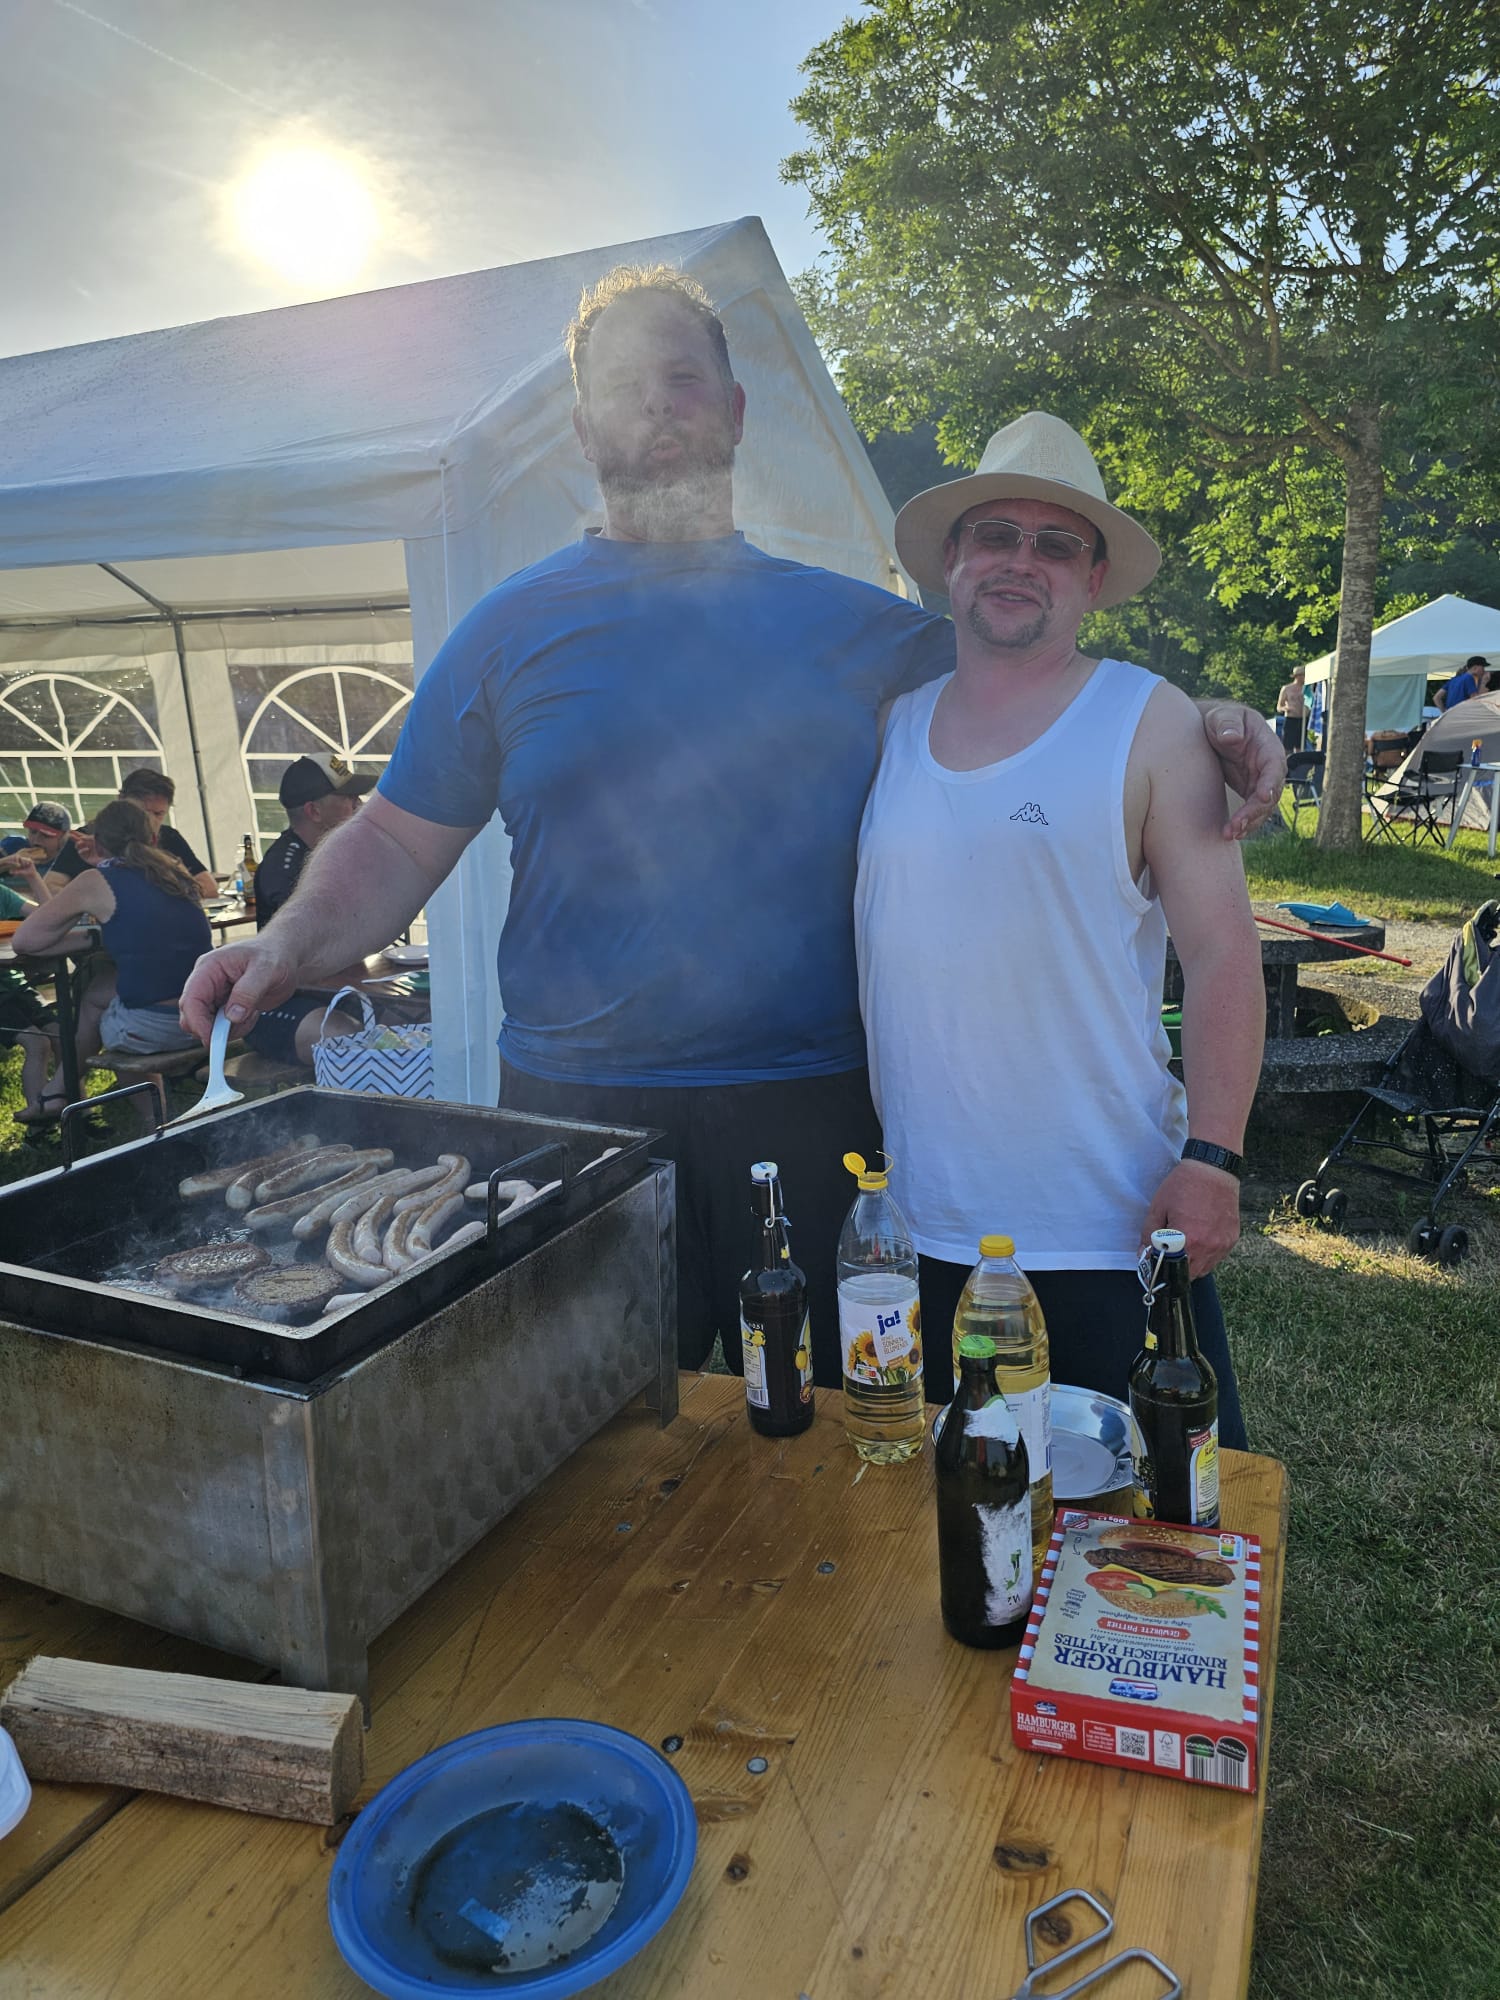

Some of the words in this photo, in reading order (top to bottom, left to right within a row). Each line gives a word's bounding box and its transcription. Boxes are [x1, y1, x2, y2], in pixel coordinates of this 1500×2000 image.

[876, 1310, 901, 1336] ja!
[1054, 1633, 1121, 1655] PATTIES
[1054, 1645, 1228, 1689] HAMBURGER
[1123, 1646, 1228, 1670] RINDFLEISCH
[1016, 1711, 1077, 1734] HAMBURGER
